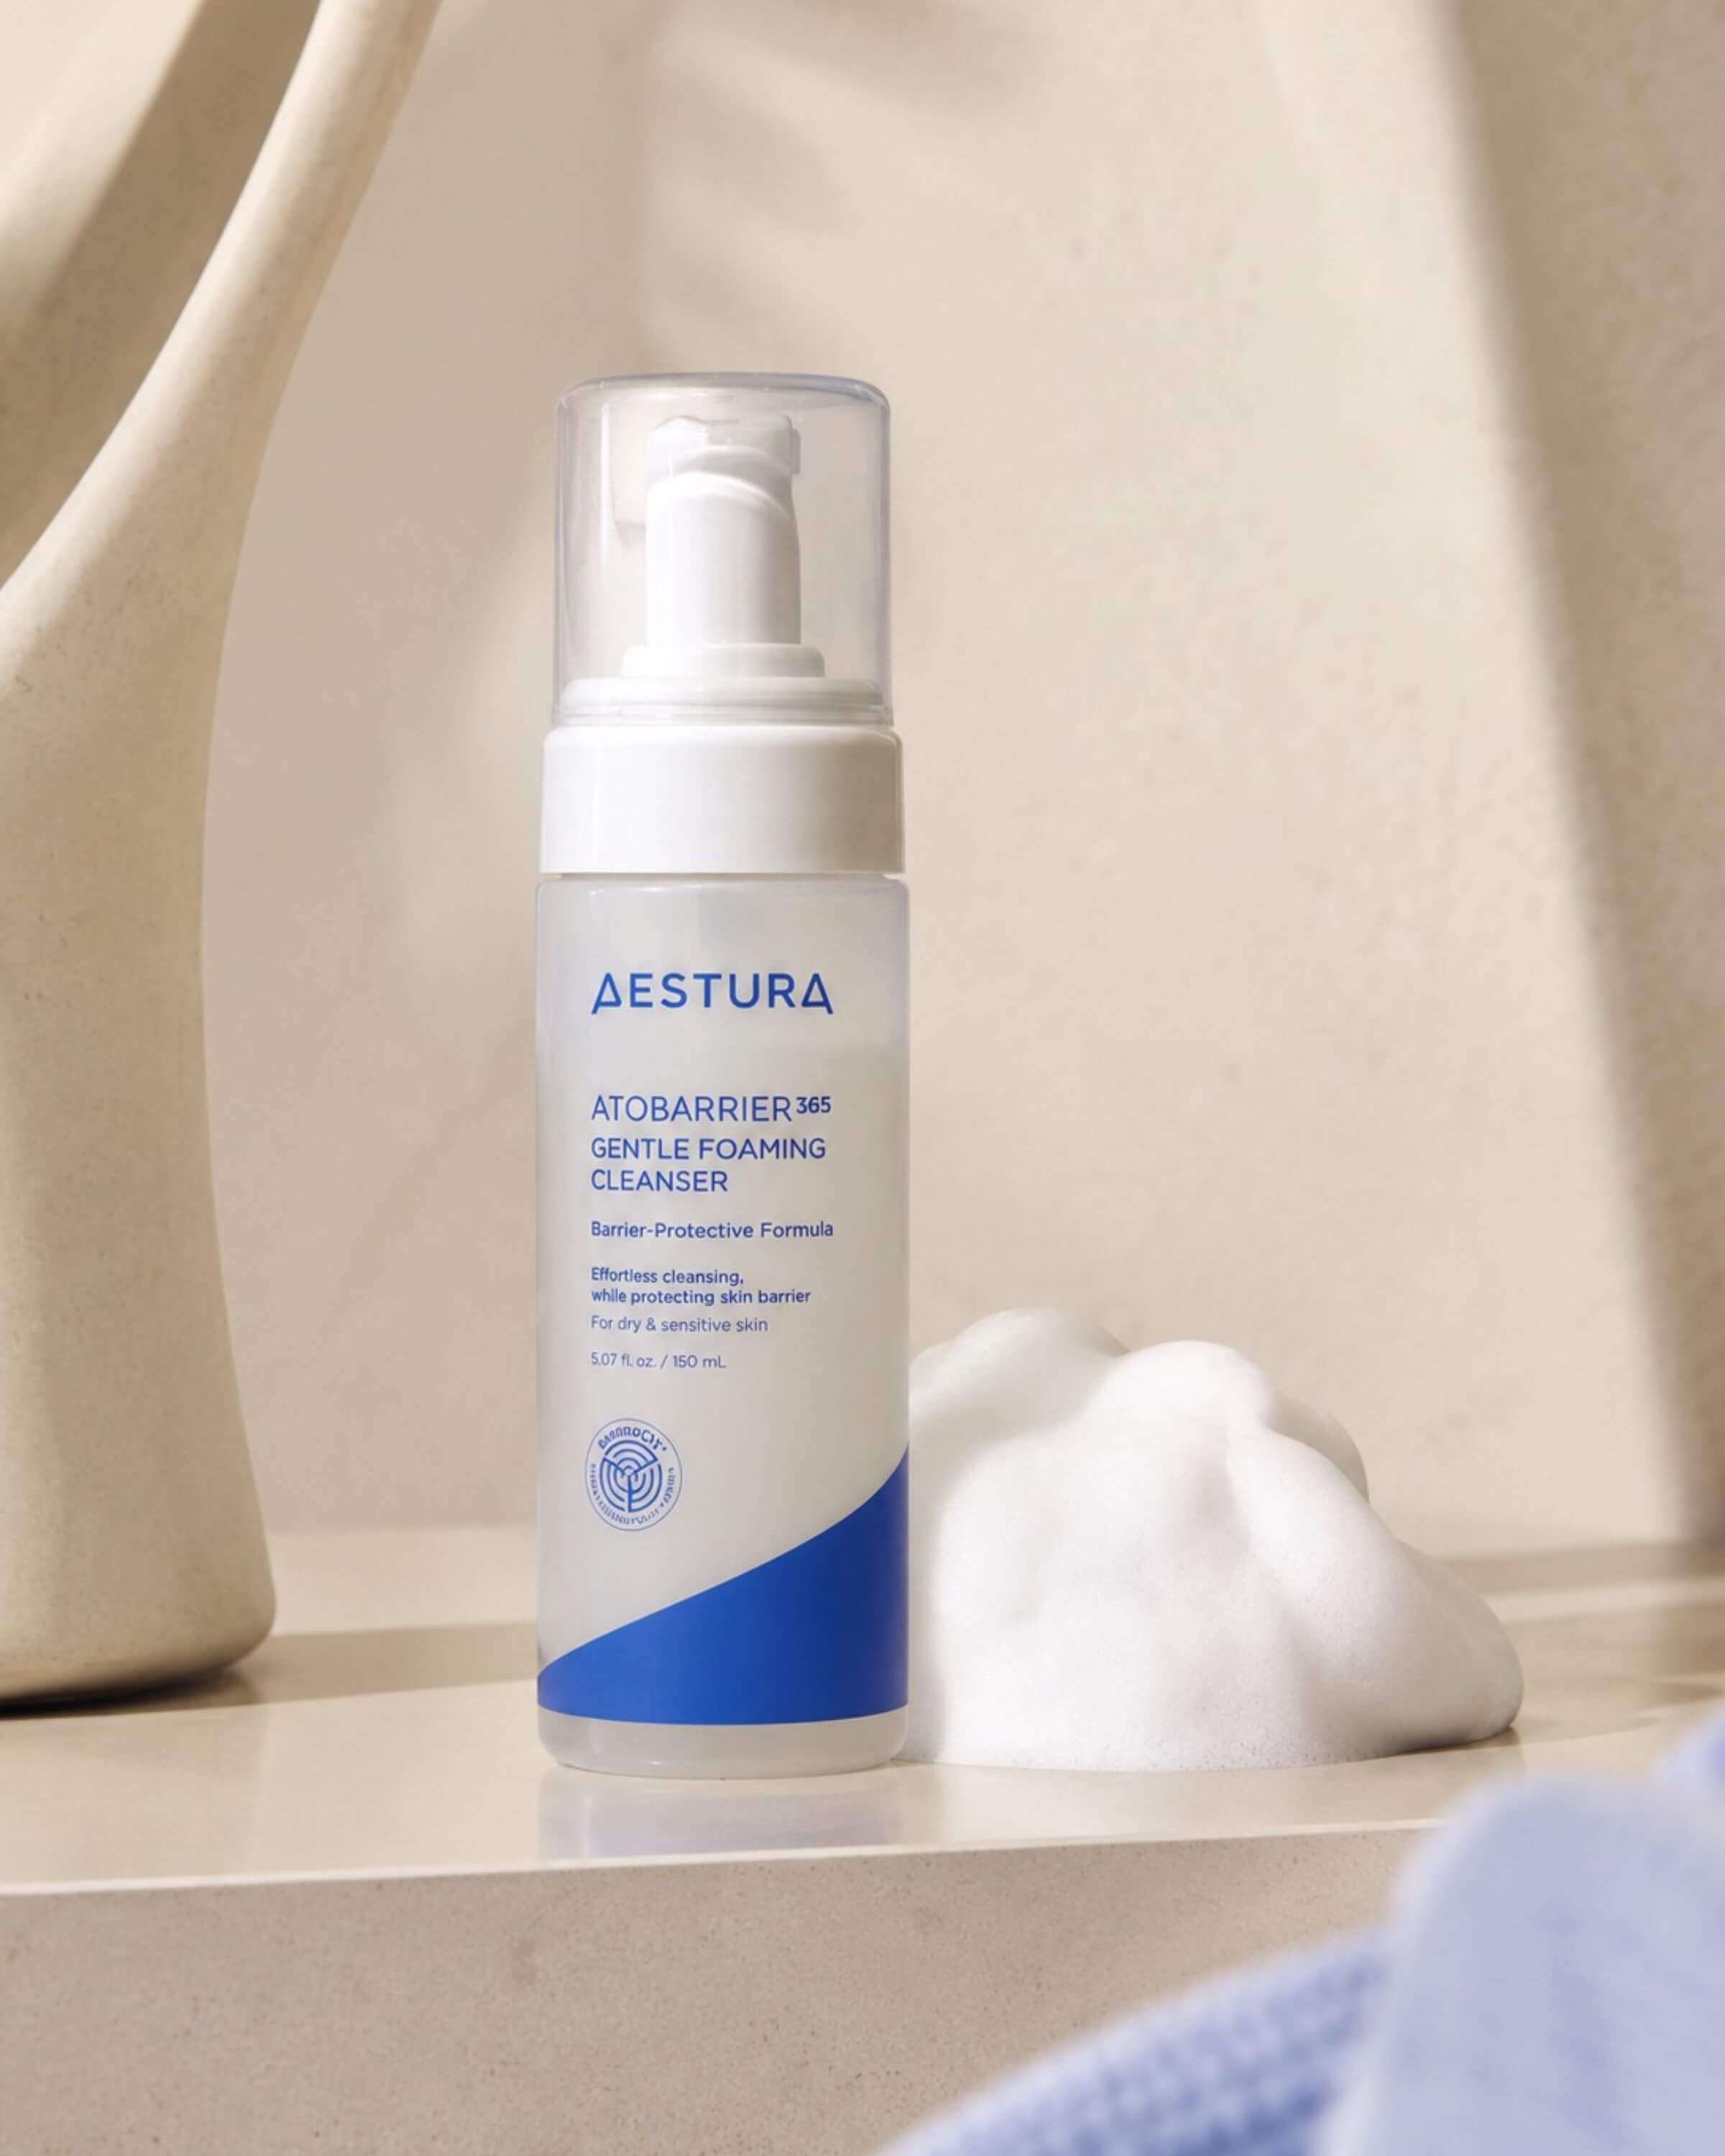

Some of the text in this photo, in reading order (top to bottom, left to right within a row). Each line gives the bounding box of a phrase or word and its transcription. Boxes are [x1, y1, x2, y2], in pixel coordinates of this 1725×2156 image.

[591, 972, 833, 1015] AESTURA
[591, 1137, 826, 1160] GENTLE FOAMING
[591, 1169, 728, 1192] CLEANSER
[592, 1221, 833, 1238] Barrier-Protective Formula
[592, 1267, 744, 1286] Effortless cleansing,
[592, 1289, 811, 1307] while protecting skin barrier
[592, 1315, 768, 1333] For dry & sensitive skin
[592, 1352, 726, 1370] 5.07 fl. oz. / 150 mL
